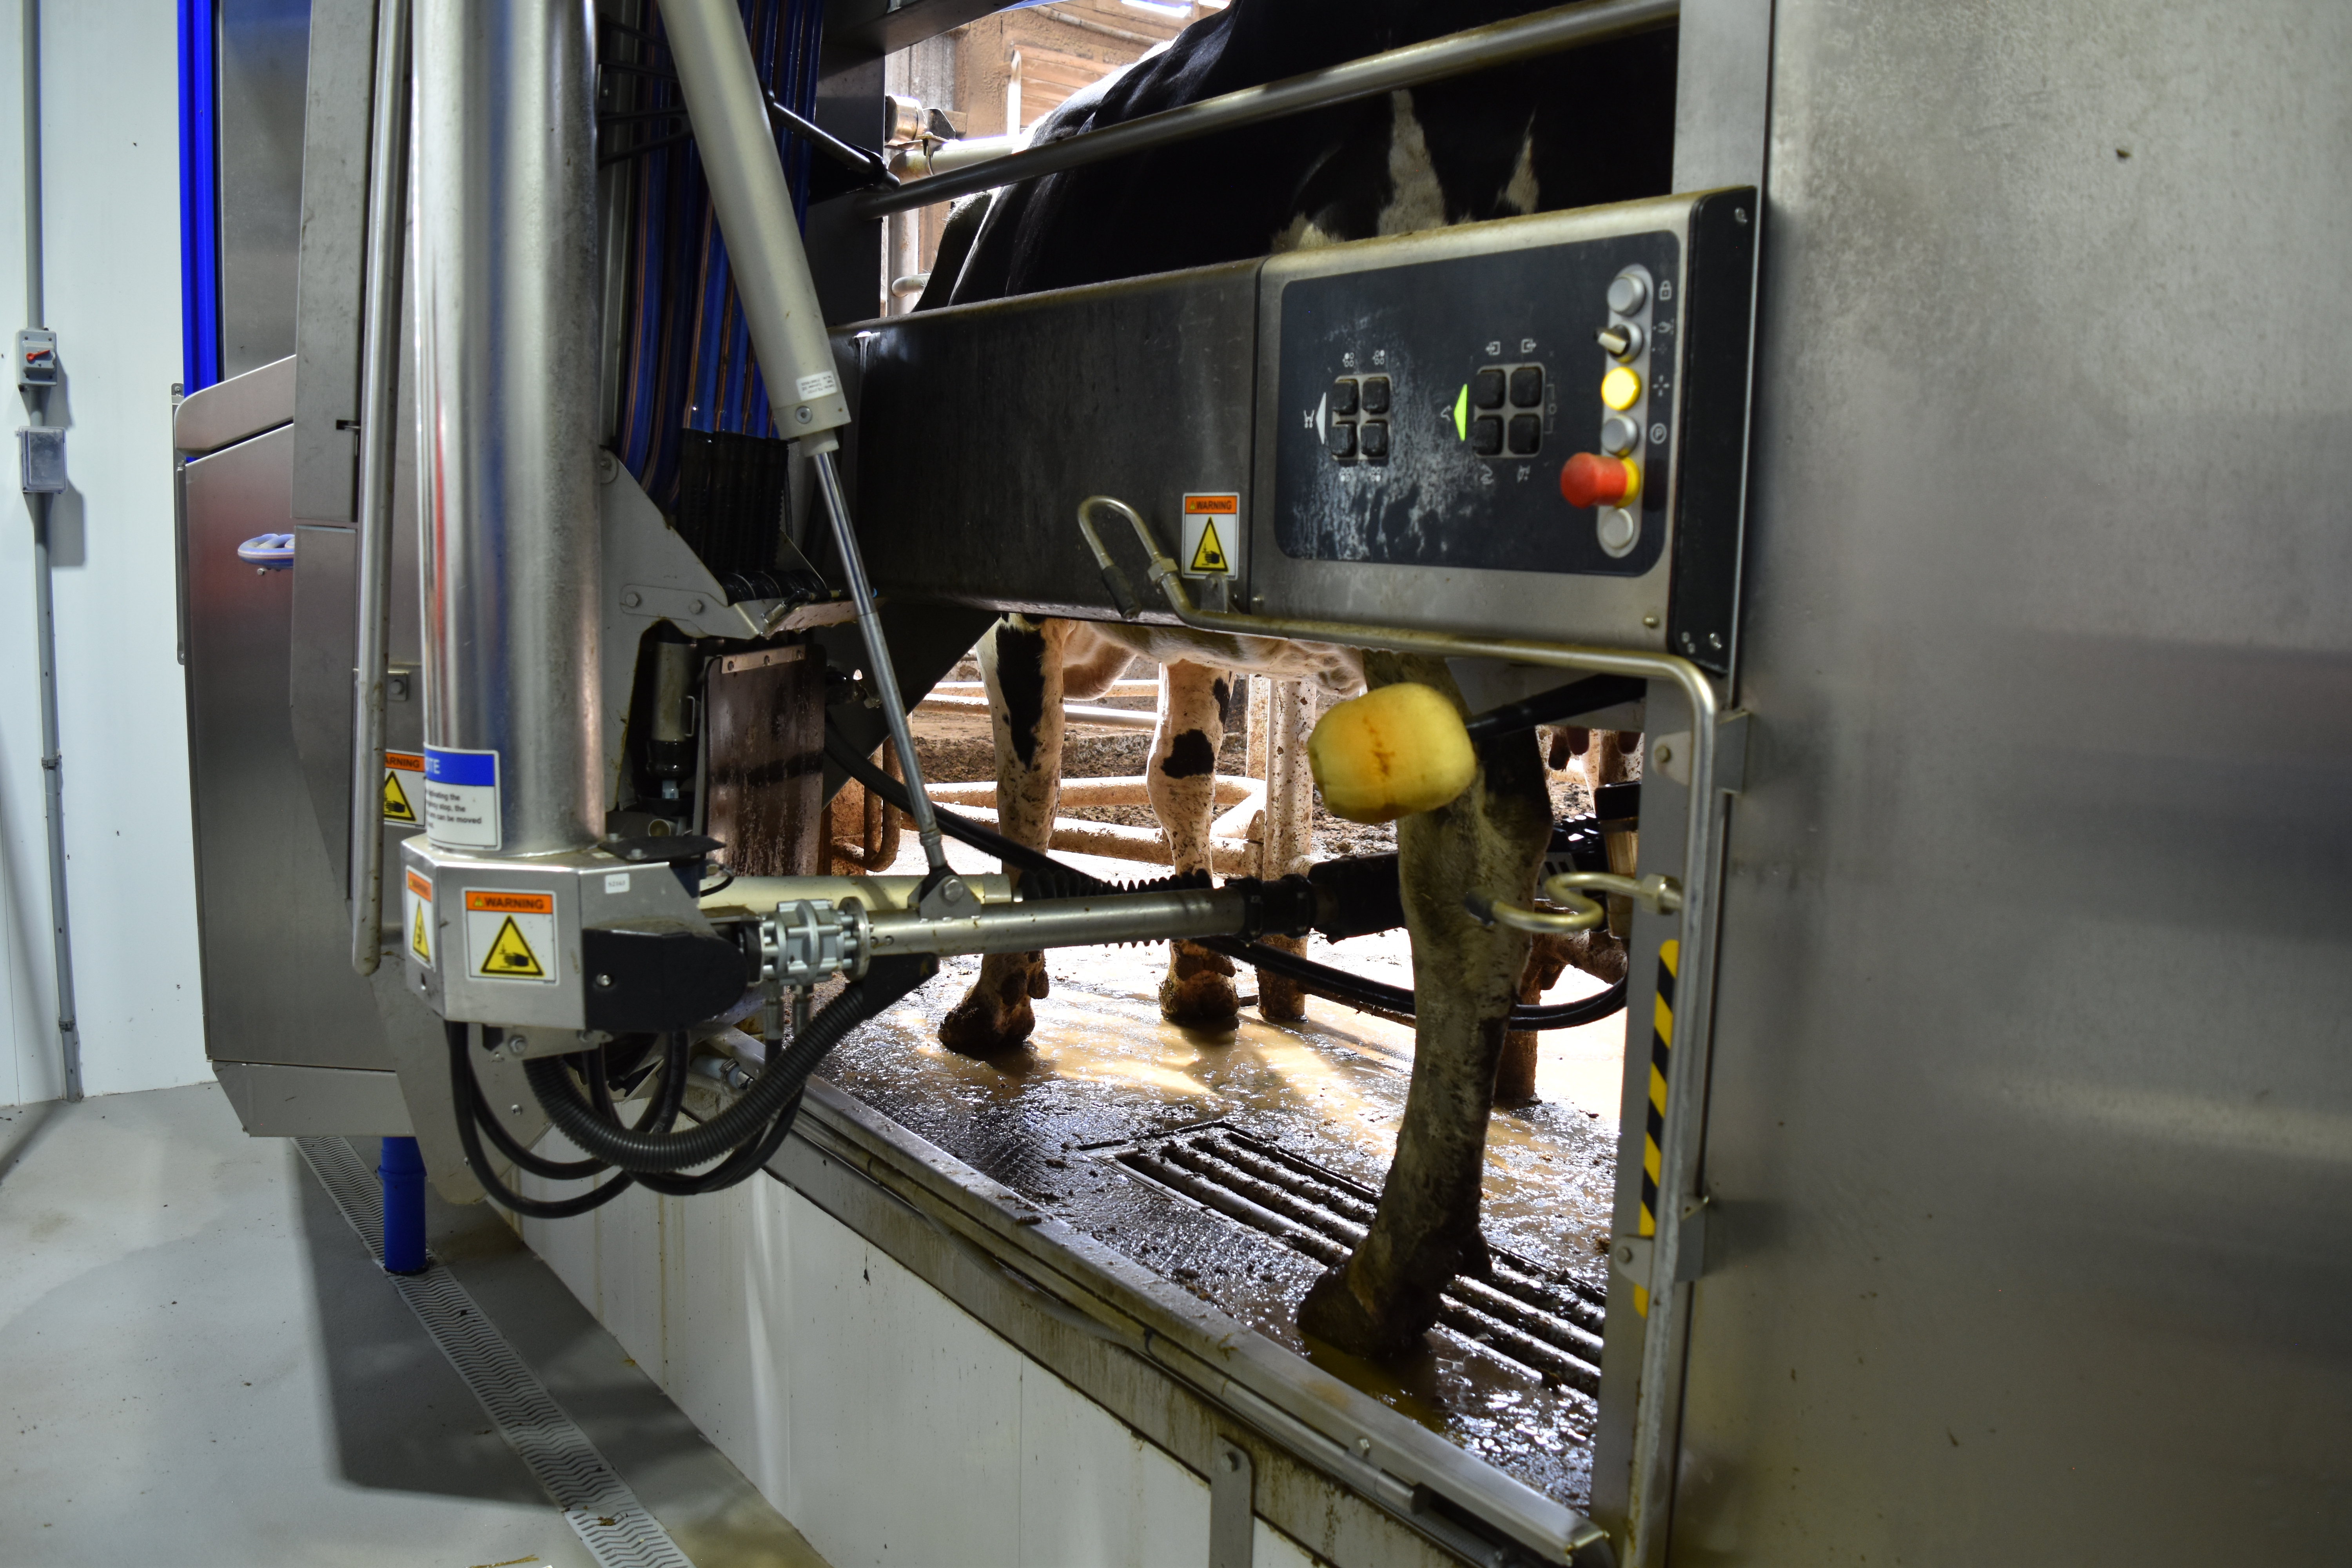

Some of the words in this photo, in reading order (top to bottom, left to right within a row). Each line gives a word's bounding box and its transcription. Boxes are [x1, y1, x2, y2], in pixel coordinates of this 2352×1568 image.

[1196, 501, 1232, 510] WARNING
[385, 757, 420, 768] ARNING
[484, 897, 544, 909] WARNING
